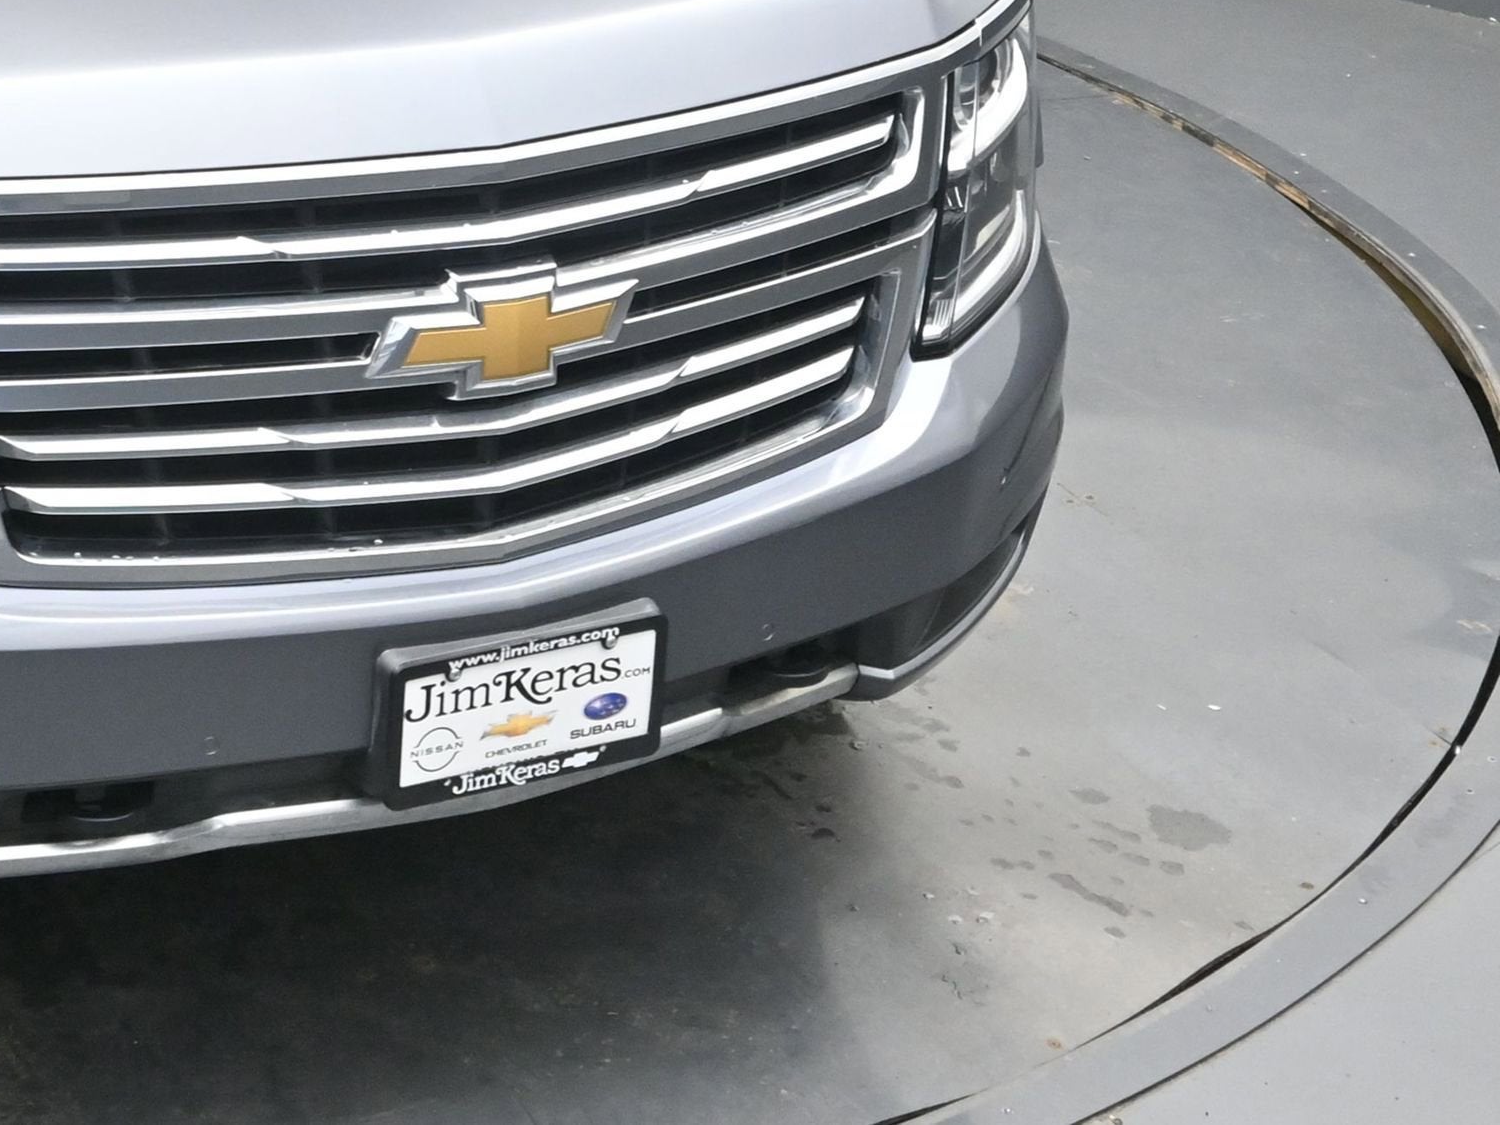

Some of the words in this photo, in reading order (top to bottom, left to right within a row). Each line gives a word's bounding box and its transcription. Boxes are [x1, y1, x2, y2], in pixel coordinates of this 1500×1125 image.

[449, 627, 620, 668] www.jimkeras.com
[570, 718, 636, 740] SUBARU
[410, 741, 463, 758] NISSAN
[485, 739, 547, 759] CHEVROLET
